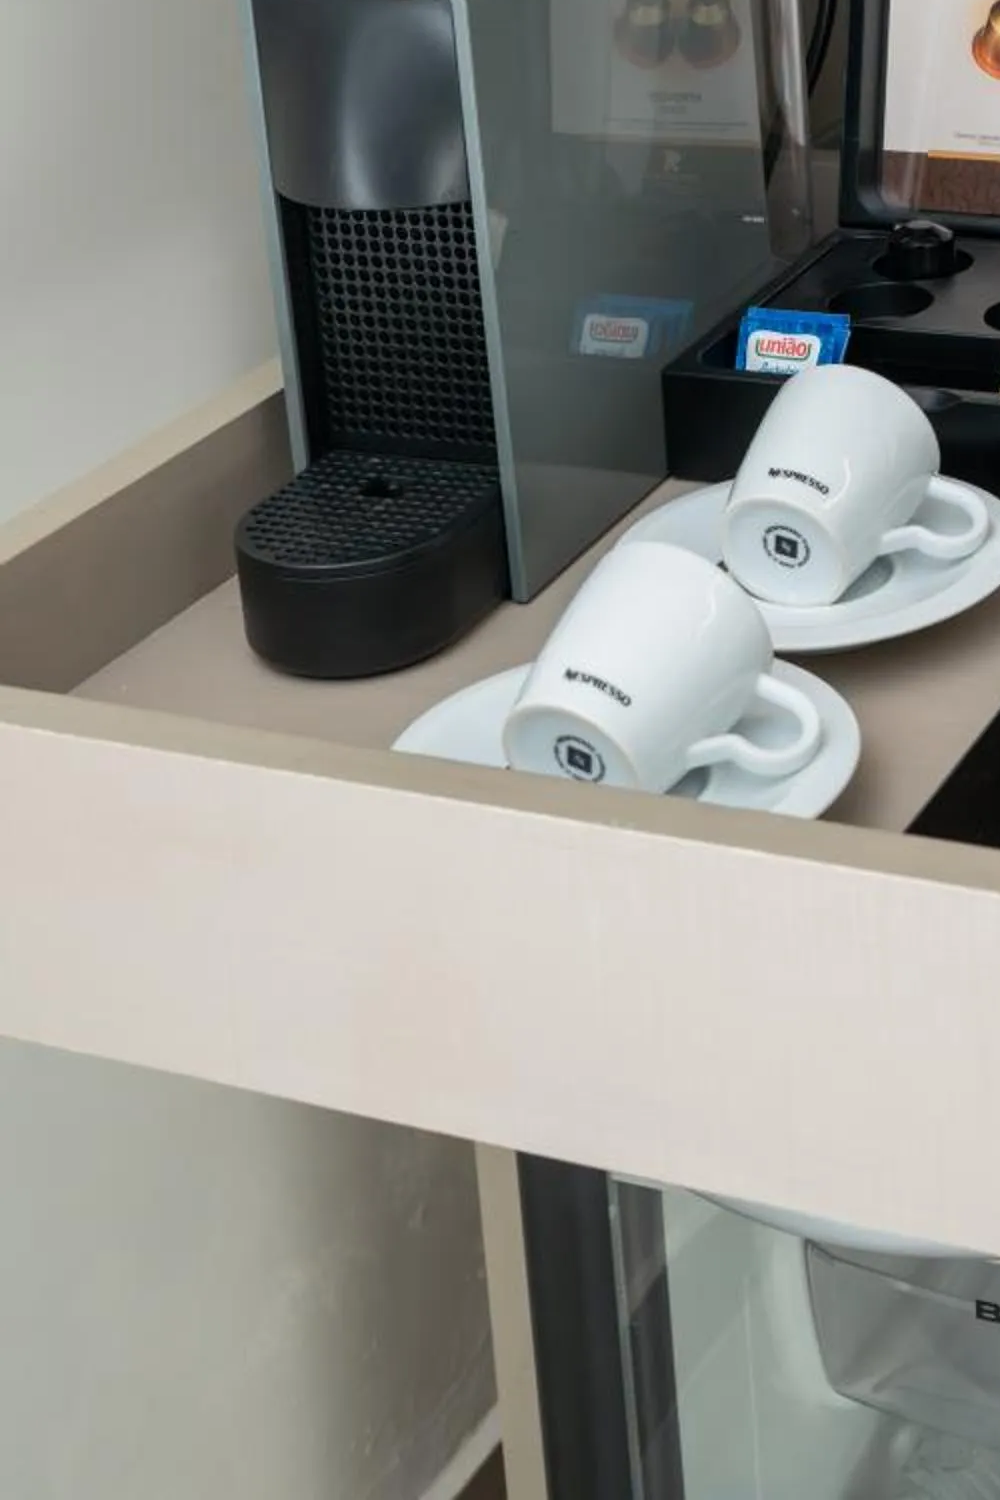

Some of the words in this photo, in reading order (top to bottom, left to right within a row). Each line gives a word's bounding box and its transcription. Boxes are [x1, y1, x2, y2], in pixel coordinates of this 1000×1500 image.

[760, 337, 807, 357] união
[768, 468, 830, 495] NESPRESSO
[564, 671, 632, 707] NESPRESSO
